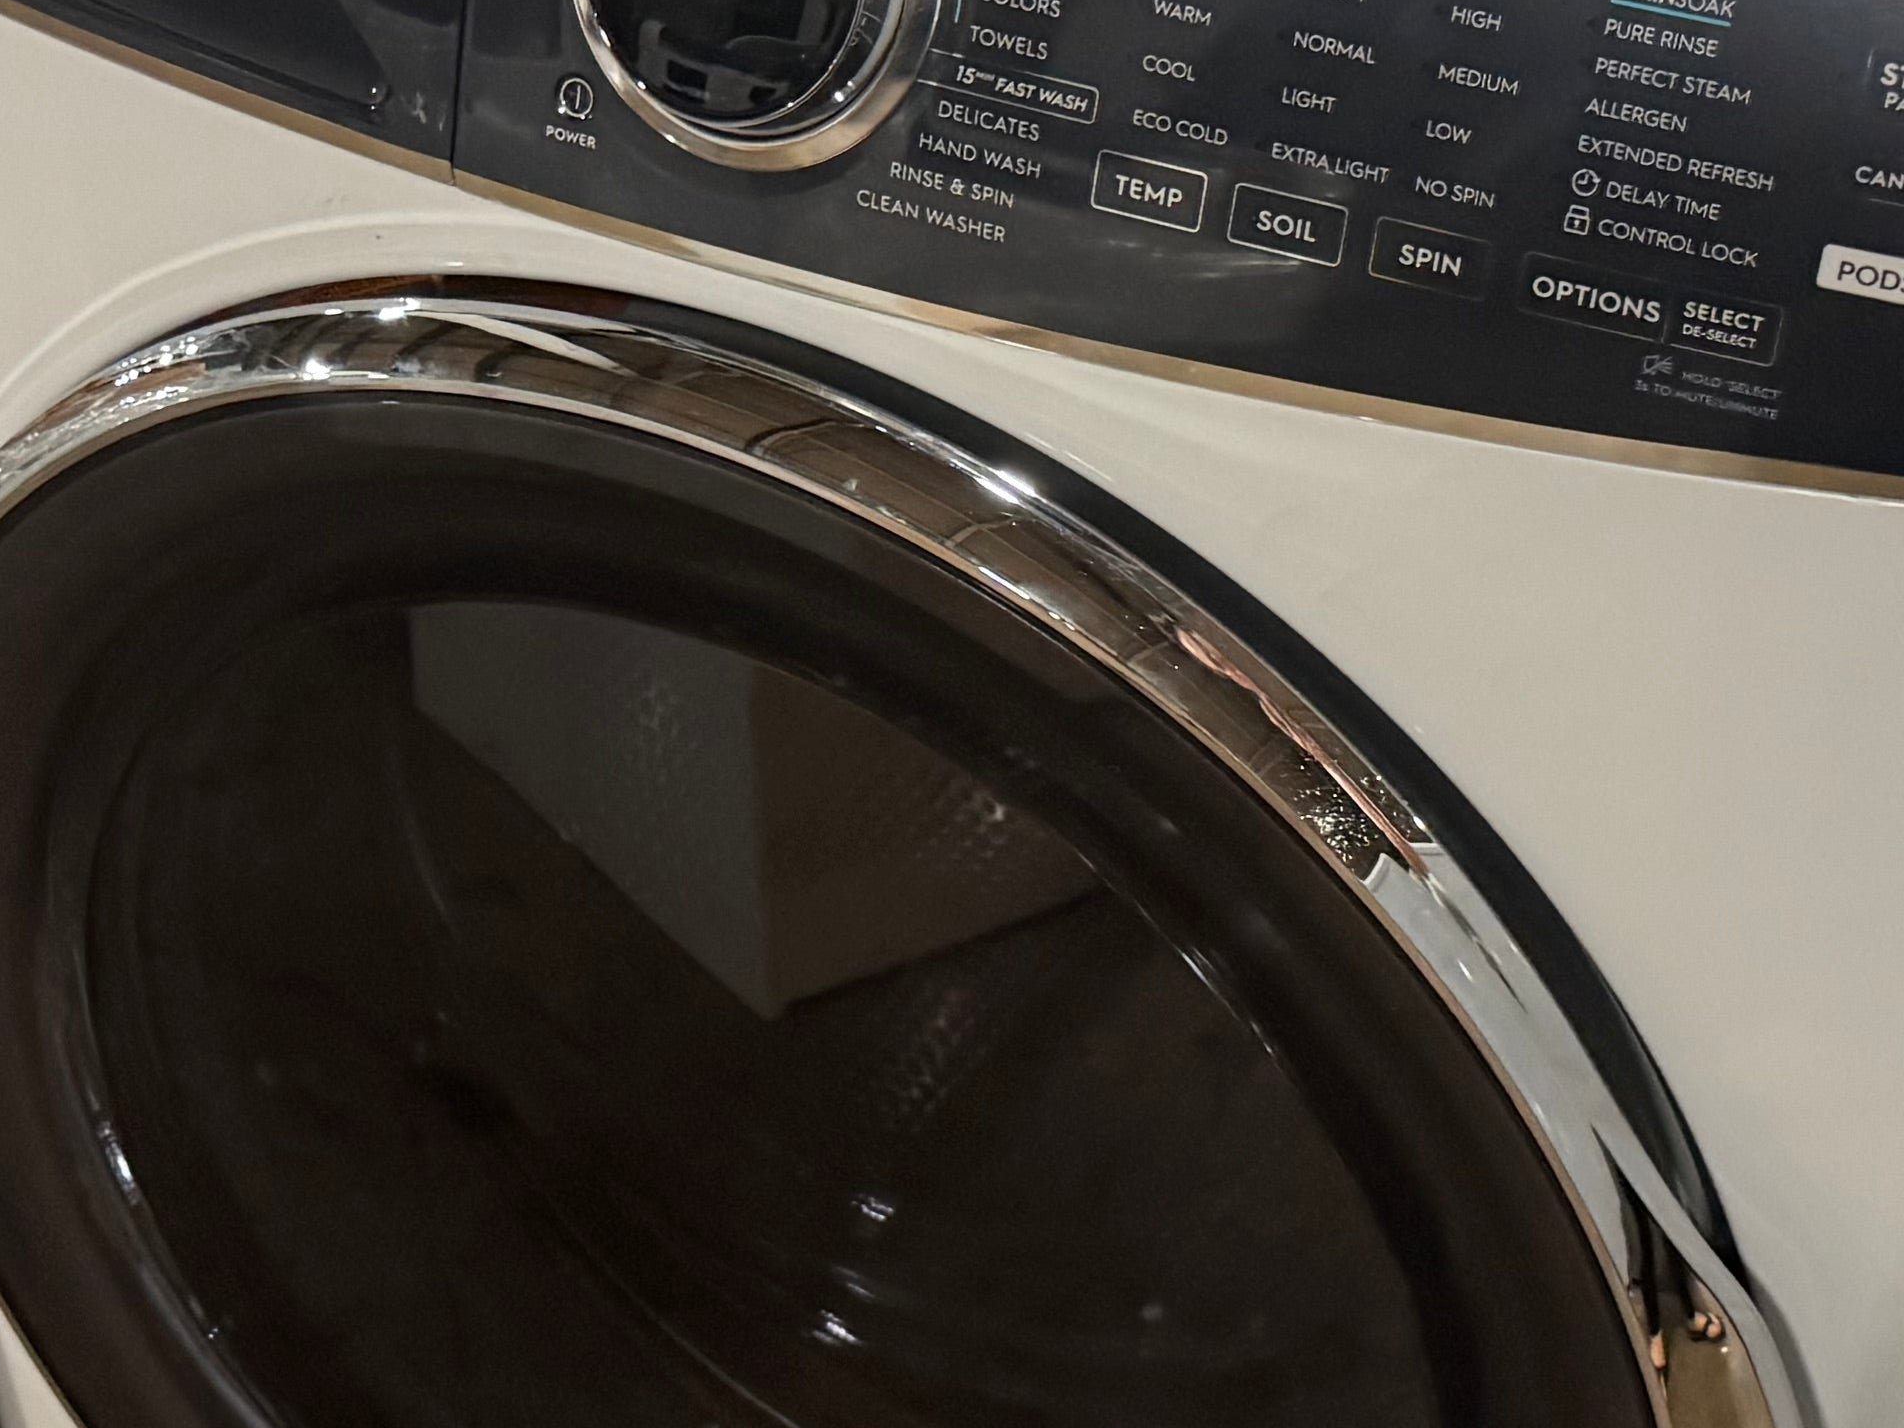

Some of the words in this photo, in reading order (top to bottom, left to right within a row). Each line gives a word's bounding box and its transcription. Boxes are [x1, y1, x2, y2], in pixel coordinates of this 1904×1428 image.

[1155, 0, 1211, 25] WARM
[1451, 6, 1501, 31] HIGH
[970, 25, 1047, 59] TOWELS
[1294, 32, 1374, 64] NORMAL
[1604, 19, 1655, 44] PURE
[1661, 31, 1718, 57] RINSE
[1143, 55, 1195, 81] COOL
[1438, 65, 1518, 95] MEDIUM
[1595, 57, 1679, 89] PERFECT
[1683, 77, 1751, 104] STEAM
[995, 78, 1036, 98] FAST
[1040, 89, 1088, 111] WASH
[1282, 87, 1336, 112] LIGHT
[938, 101, 1039, 141] DELICATES
[1133, 109, 1171, 131] ECO
[1176, 120, 1228, 145] COLD
[1585, 98, 1687, 132] ALLERGEN
[546, 125, 595, 149] POWER
[1426, 121, 1471, 143] LOW
[919, 133, 976, 161] HAND
[984, 149, 1041, 178] WASH
[1272, 143, 1330, 172] EXTRA
[1335, 158, 1389, 183] LIGHT
[1578, 135, 1682, 171] EXTENDED
[1687, 159, 1773, 191] REFRESH
[890, 162, 943, 190] RINSE
[950, 179, 965, 195] &
[971, 184, 1014, 208] SPIN
[1116, 175, 1182, 207] TEMP
[1416, 176, 1447, 197] NO
[1451, 185, 1494, 208] SPIN
[1606, 181, 1670, 208] DELAY
[1675, 196, 1721, 220] TIME
[857, 190, 918, 218] CLEAN
[927, 207, 1005, 242] WASHER
[1257, 211, 1315, 242] SOIL
[1598, 219, 1694, 254] CONTROL
[1702, 242, 1758, 267] LOCK
[1399, 244, 1461, 276] SPIN
[1533, 277, 1660, 322] OPTIONS
[1684, 302, 1764, 331] SELECT
[1683, 324, 1756, 348] DE-SELECT
